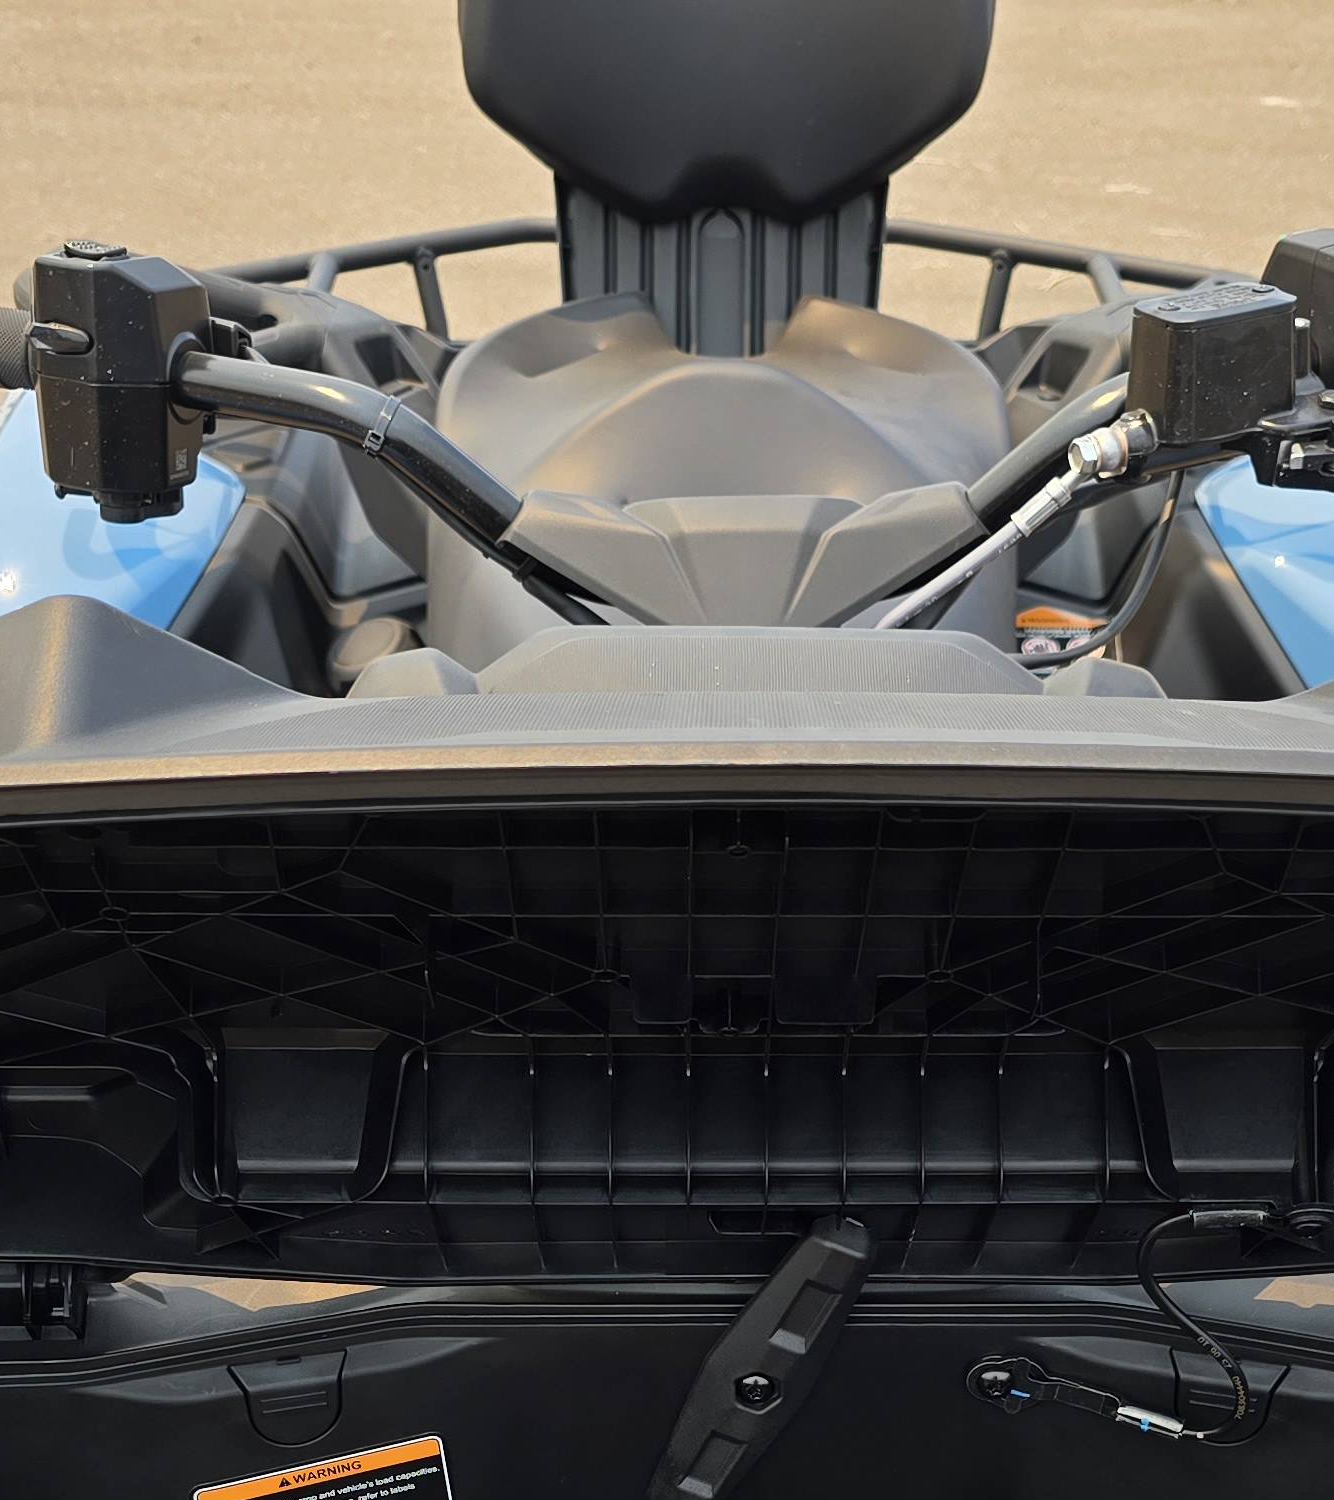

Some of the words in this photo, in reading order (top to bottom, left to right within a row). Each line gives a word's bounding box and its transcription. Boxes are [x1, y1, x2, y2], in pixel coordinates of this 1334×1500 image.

[292, 1460, 362, 1484] WARNING
[318, 1489, 335, 1499] and
[336, 1480, 374, 1495] vehicle's
[374, 1475, 394, 1486] load
[379, 1488, 388, 1496] to
[389, 1482, 415, 1494] labels
